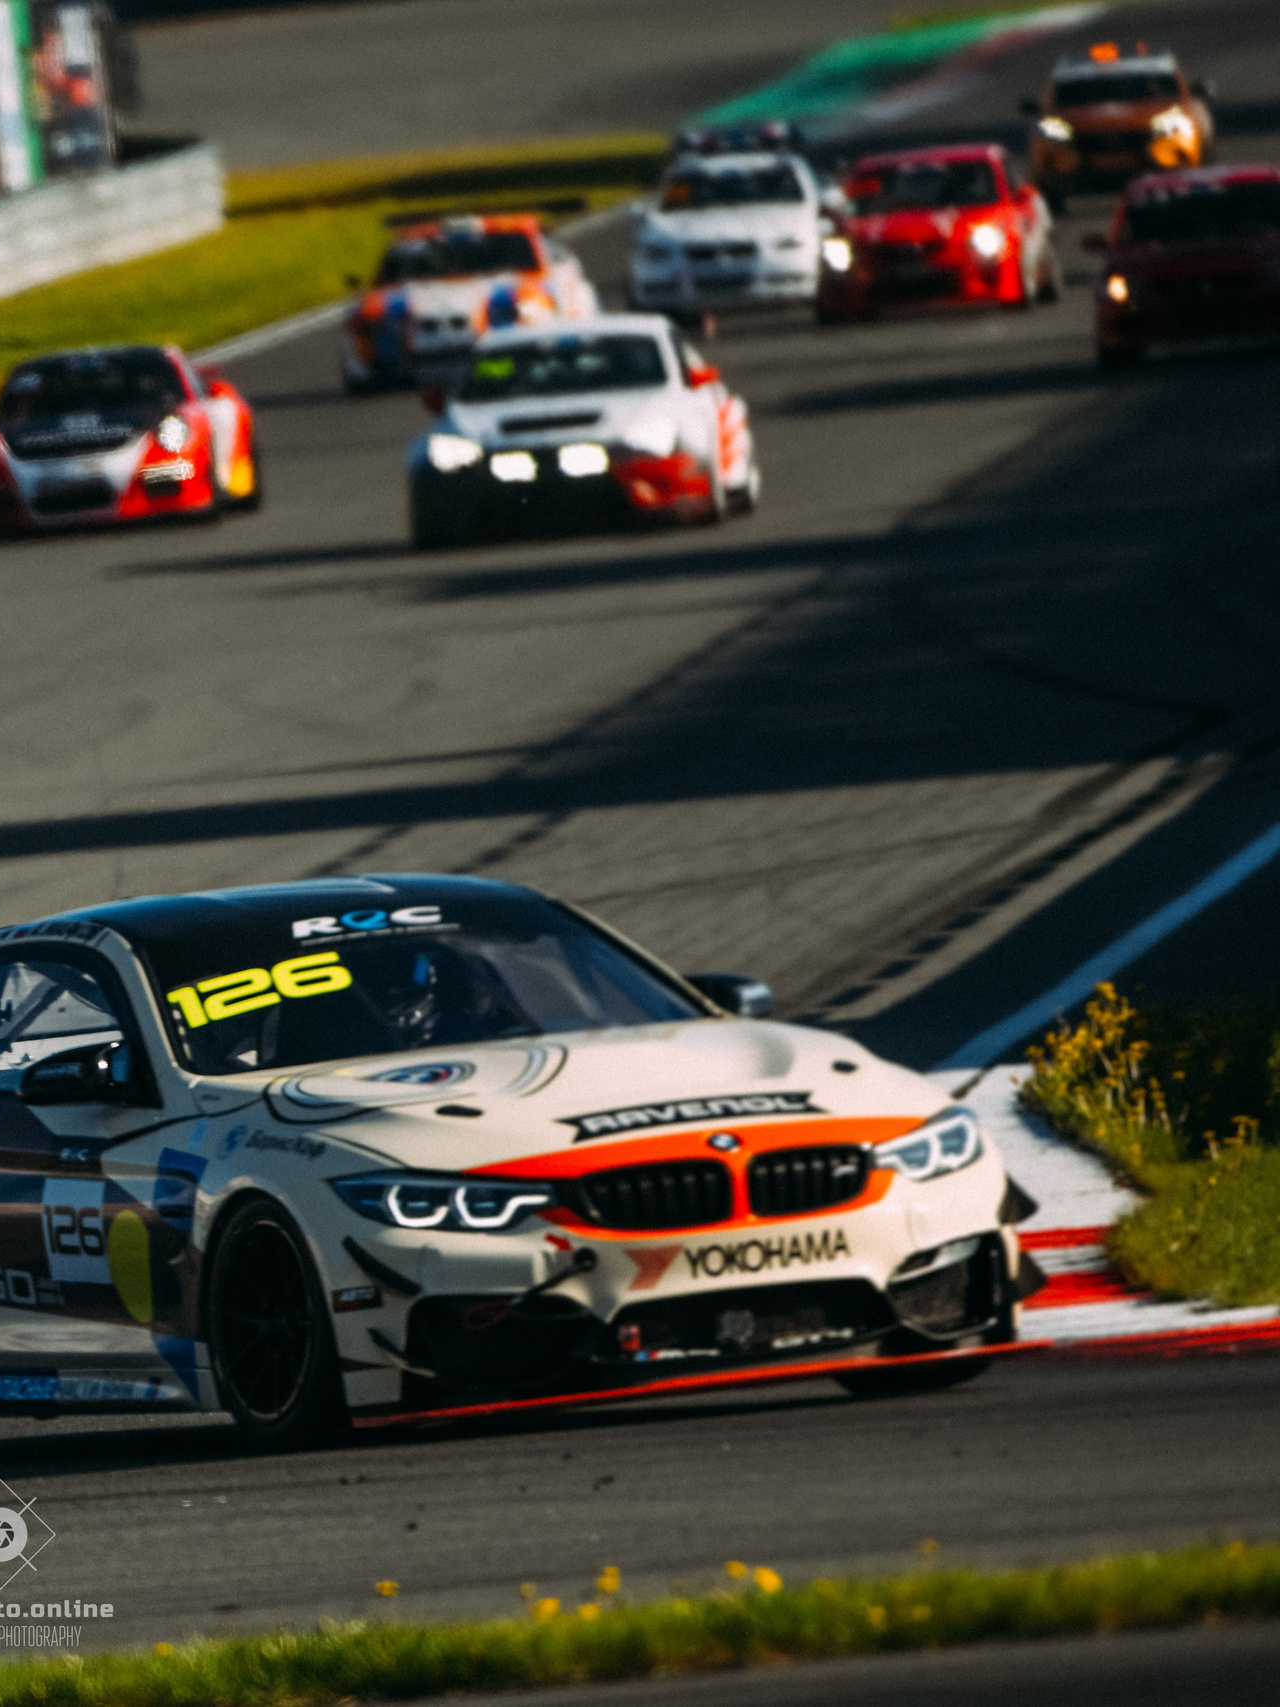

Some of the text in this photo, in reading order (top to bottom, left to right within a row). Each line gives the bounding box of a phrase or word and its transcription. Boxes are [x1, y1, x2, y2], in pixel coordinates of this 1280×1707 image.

[166, 951, 353, 1029] 126
[581, 1095, 802, 1134] RAVENOL
[43, 1206, 105, 1257] 126
[684, 1229, 851, 1279] YOKOHAMA
